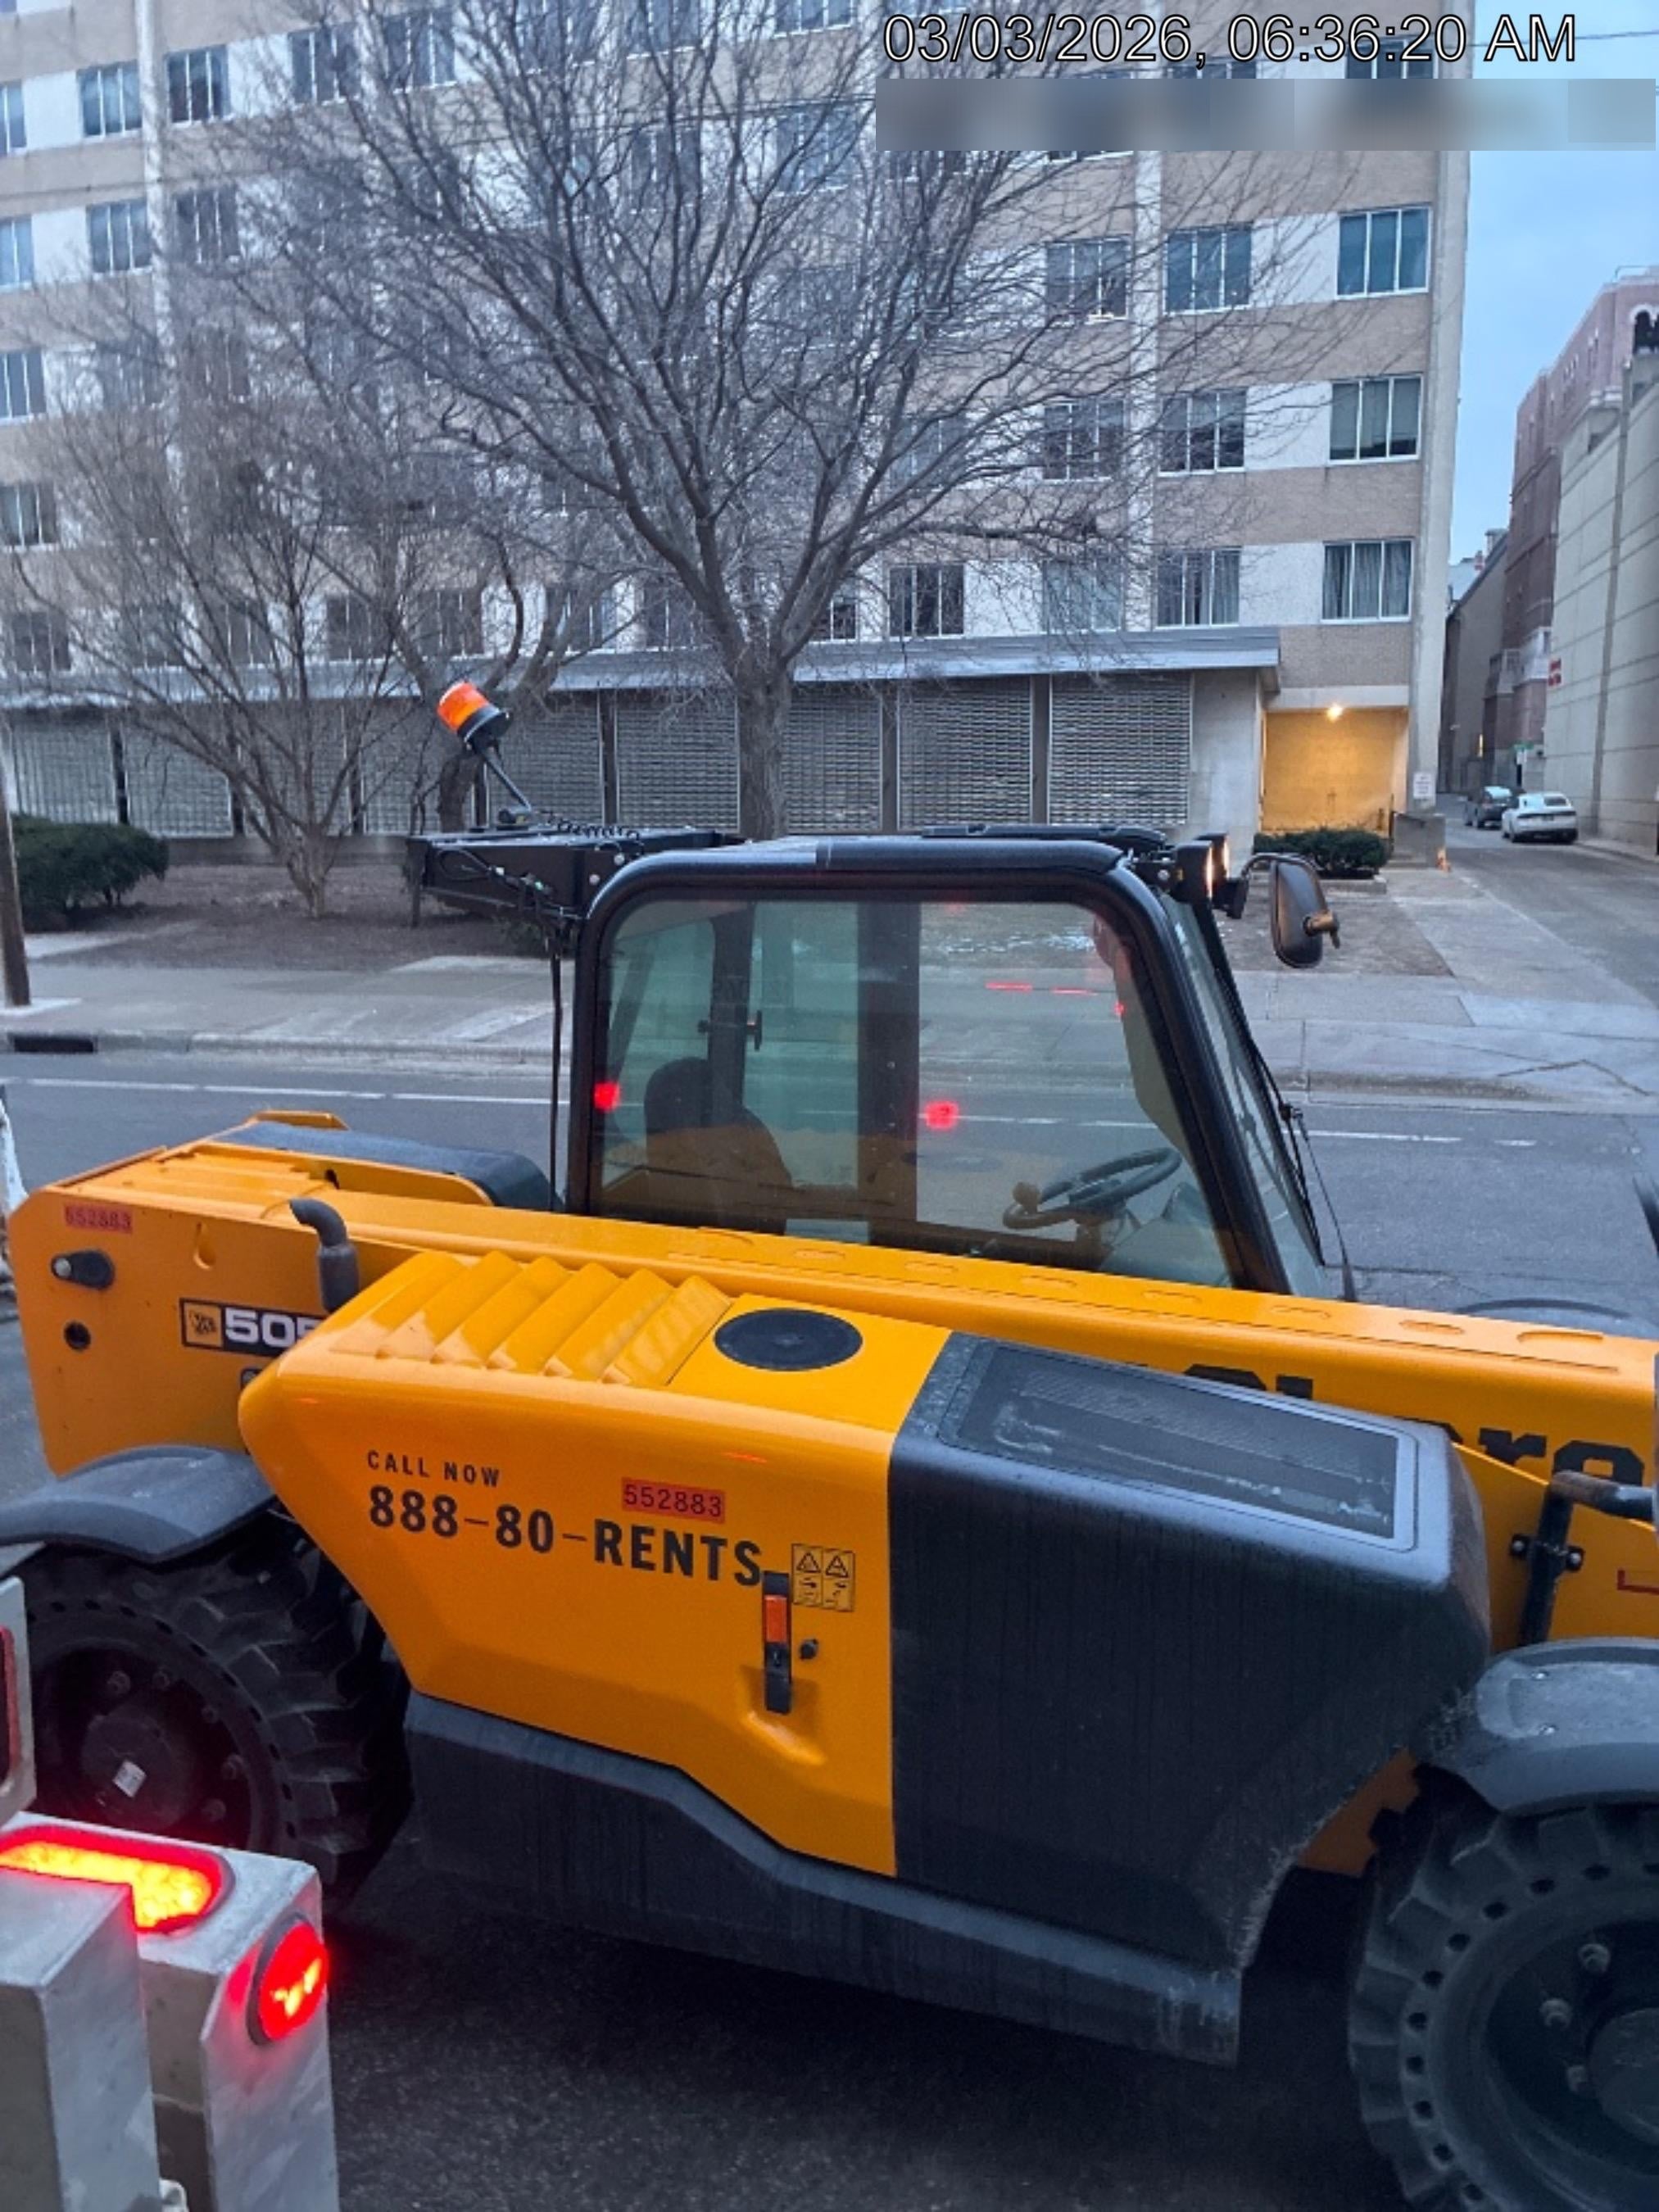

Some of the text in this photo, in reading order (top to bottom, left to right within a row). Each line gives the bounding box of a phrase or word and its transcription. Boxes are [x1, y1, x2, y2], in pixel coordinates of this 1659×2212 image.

[368, 1450, 499, 1487] CALL NOW
[623, 1484, 721, 1517] 552883
